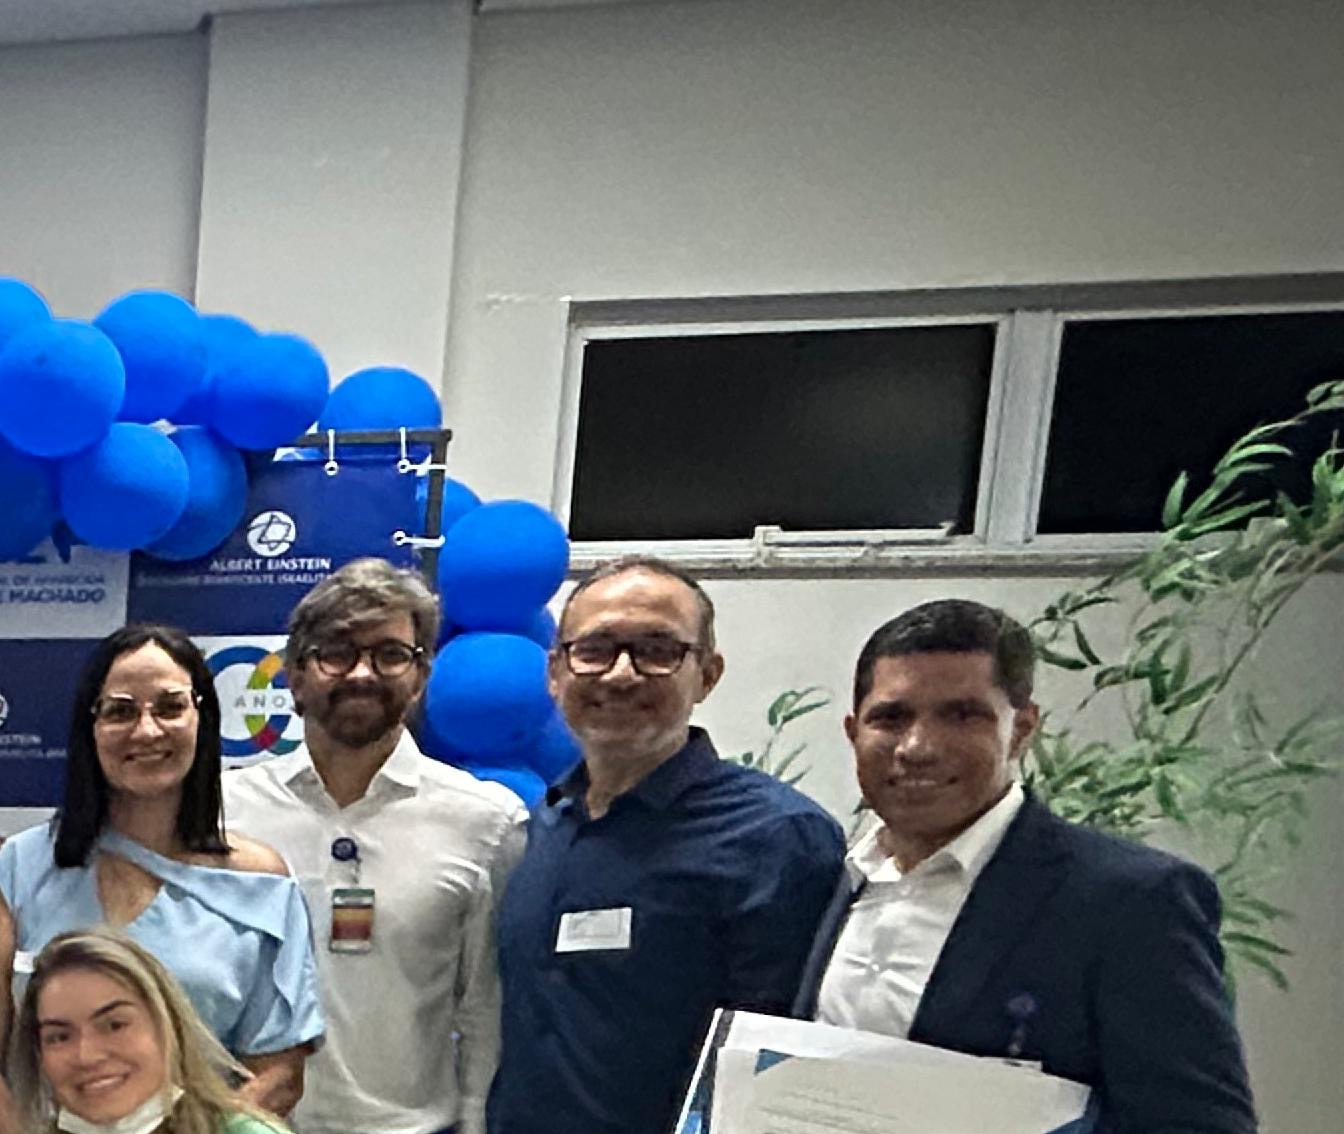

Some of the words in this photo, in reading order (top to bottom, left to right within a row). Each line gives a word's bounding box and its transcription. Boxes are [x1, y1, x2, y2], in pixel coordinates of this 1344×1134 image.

[209, 558, 262, 571] ALBERT
[266, 558, 331, 570] EINSTEIN
[10, 588, 106, 604] MACHADO
[234, 694, 288, 710] ANO
